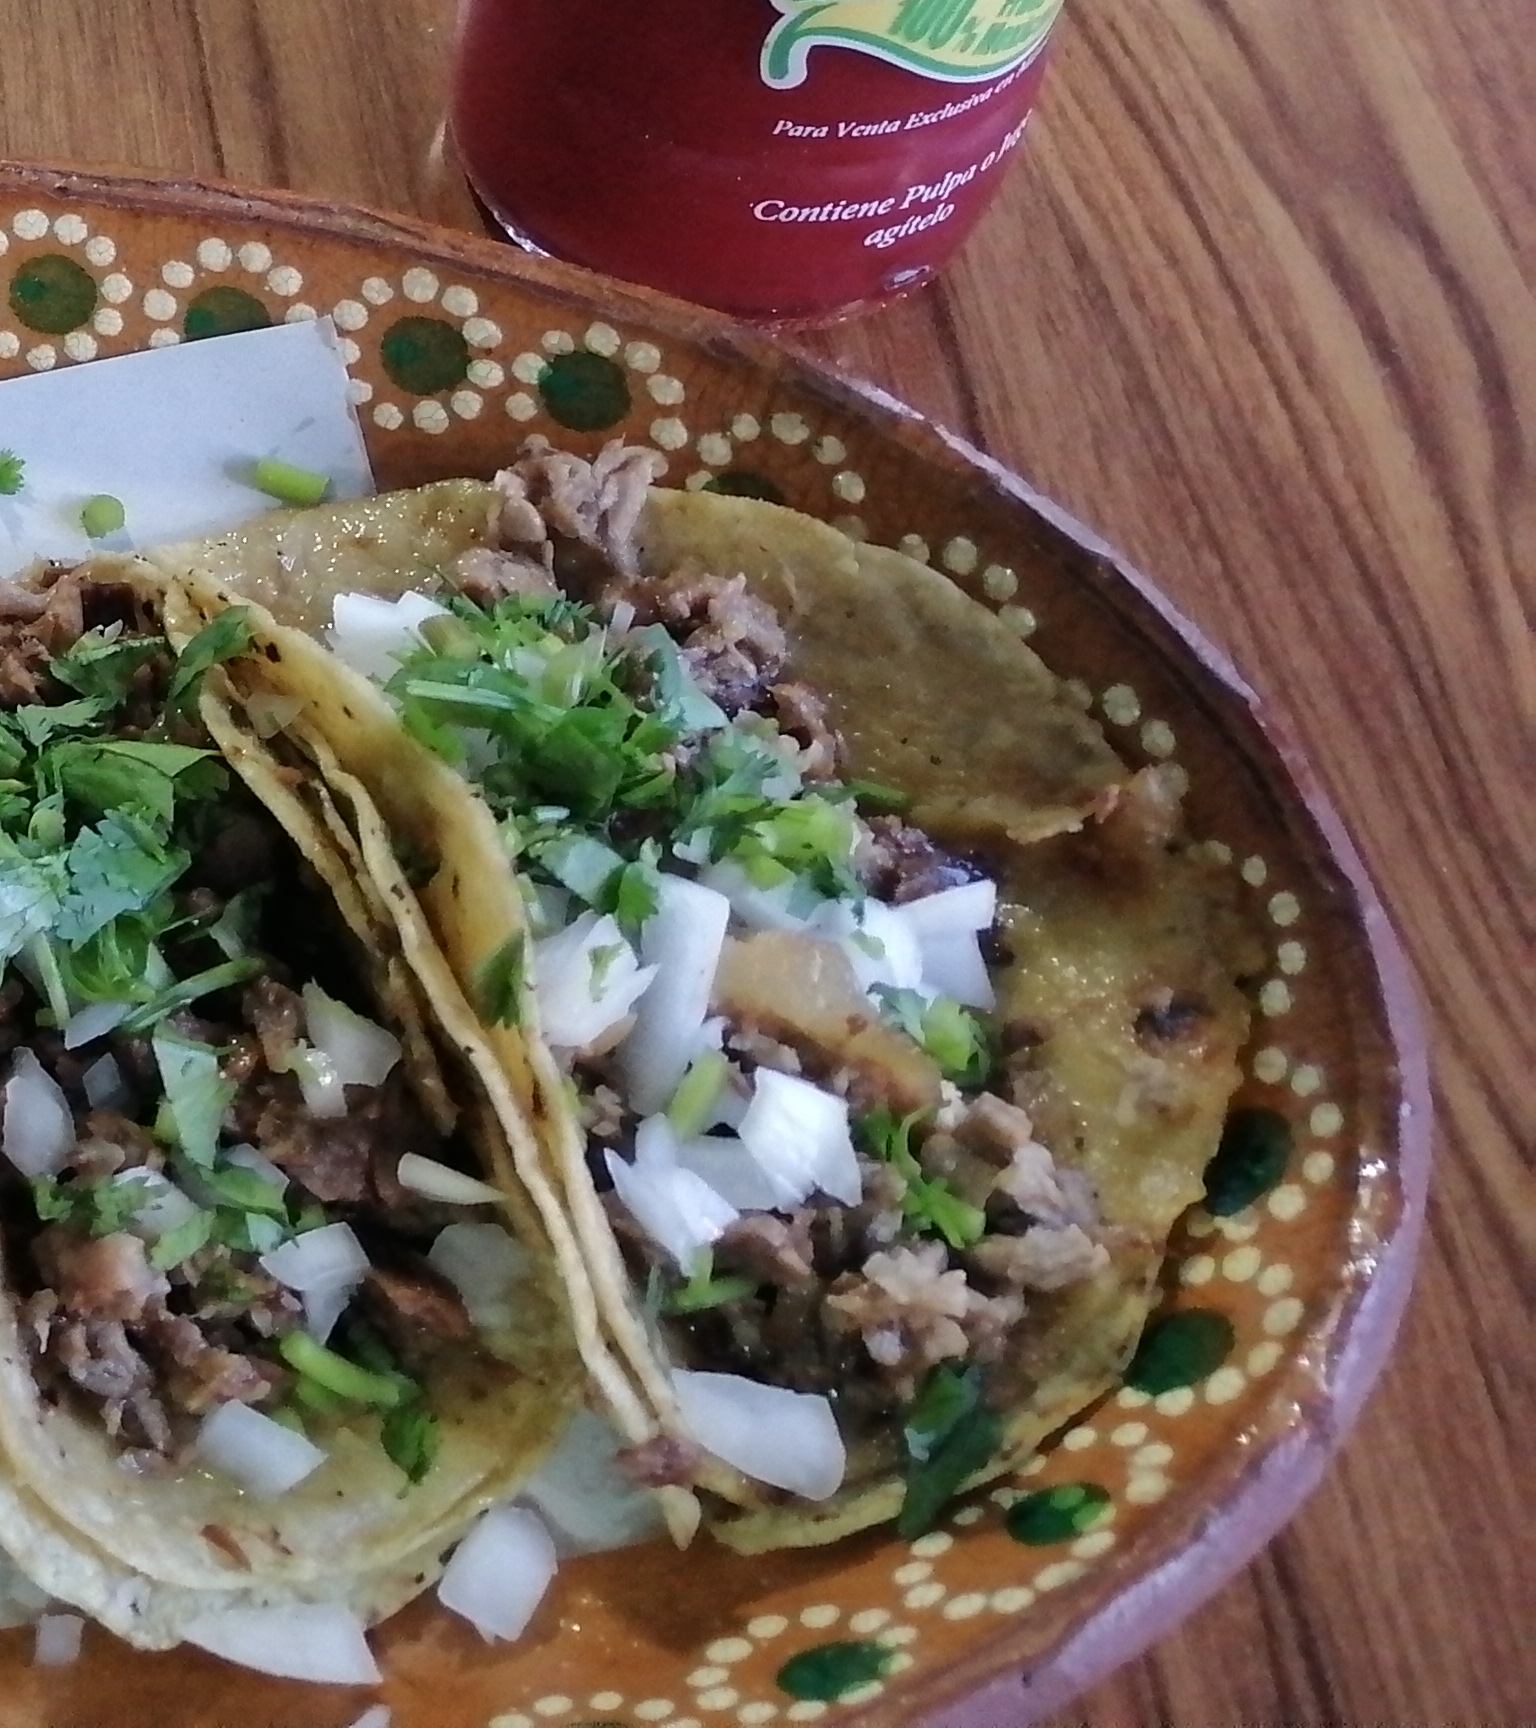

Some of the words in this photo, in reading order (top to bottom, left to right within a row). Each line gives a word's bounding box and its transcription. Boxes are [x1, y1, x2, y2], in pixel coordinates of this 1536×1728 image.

[772, 120, 829, 138] Para
[836, 119, 901, 138] Venta
[904, 85, 993, 131] Exclusiva
[993, 73, 1014, 94] en
[752, 196, 896, 223] Contiene
[899, 164, 977, 210] Pulpa
[980, 150, 996, 173] o
[863, 202, 956, 249] agítelo
